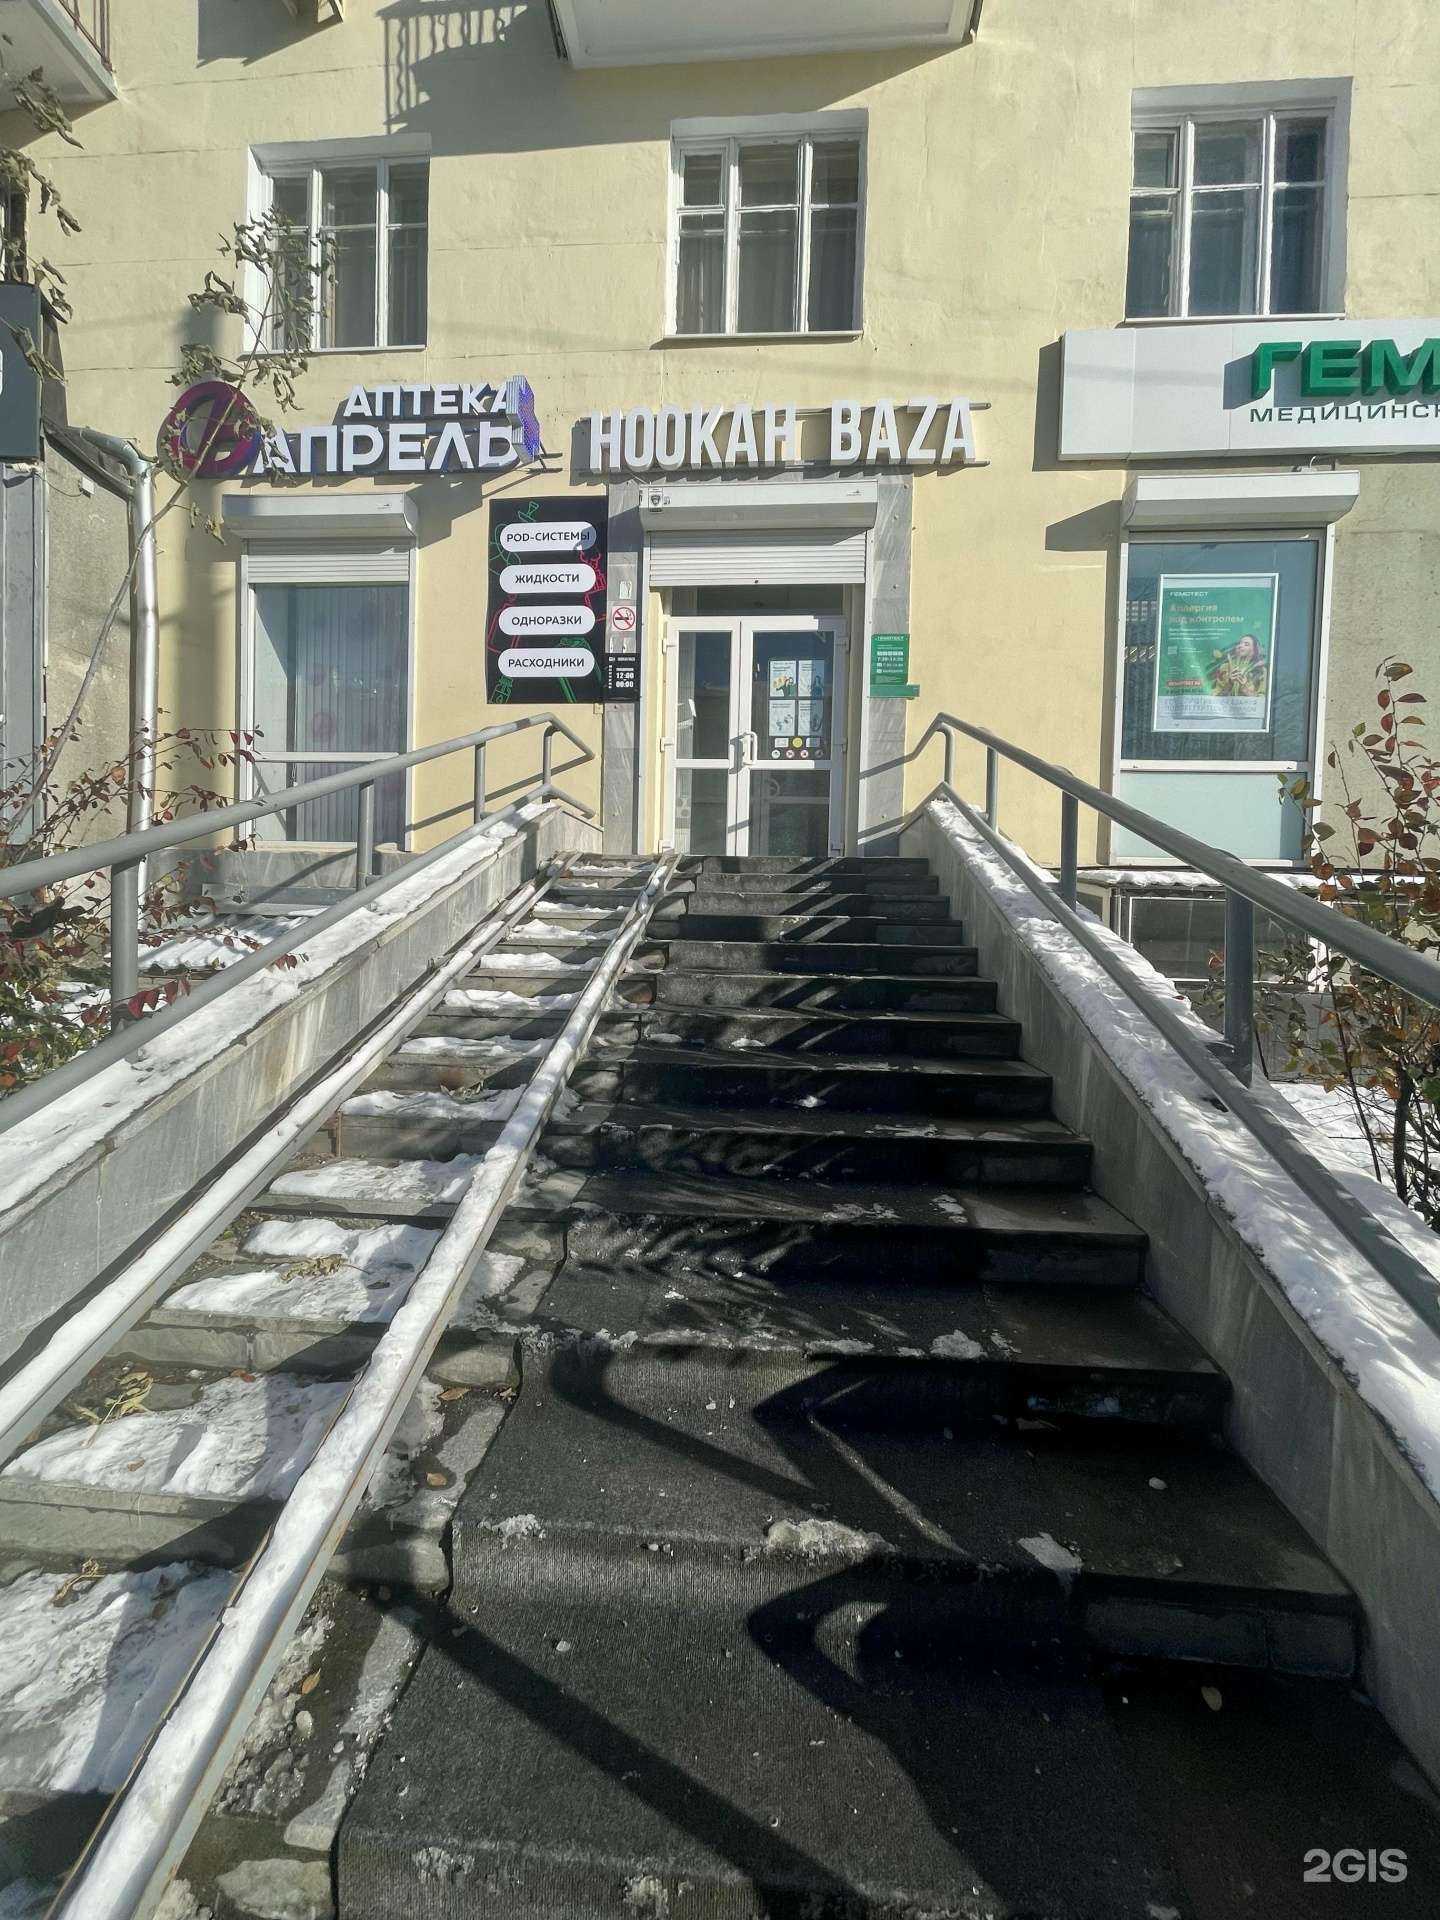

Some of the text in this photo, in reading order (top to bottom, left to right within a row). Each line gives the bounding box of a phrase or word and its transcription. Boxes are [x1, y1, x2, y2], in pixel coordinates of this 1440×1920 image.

[1253, 338, 1440, 396] ГЕМ
[343, 383, 507, 417] АПТЕКА
[589, 396, 977, 472] HOOKAH BAZA
[252, 420, 519, 474] АПРЕЛЬ
[506, 531, 590, 543] POD-СИСТЕМЫ
[515, 573, 580, 585] ЖИДКОСТИ
[511, 615, 582, 627] ОДНОРАЗКИ
[508, 658, 585, 670] РАСХОДНИКИ
